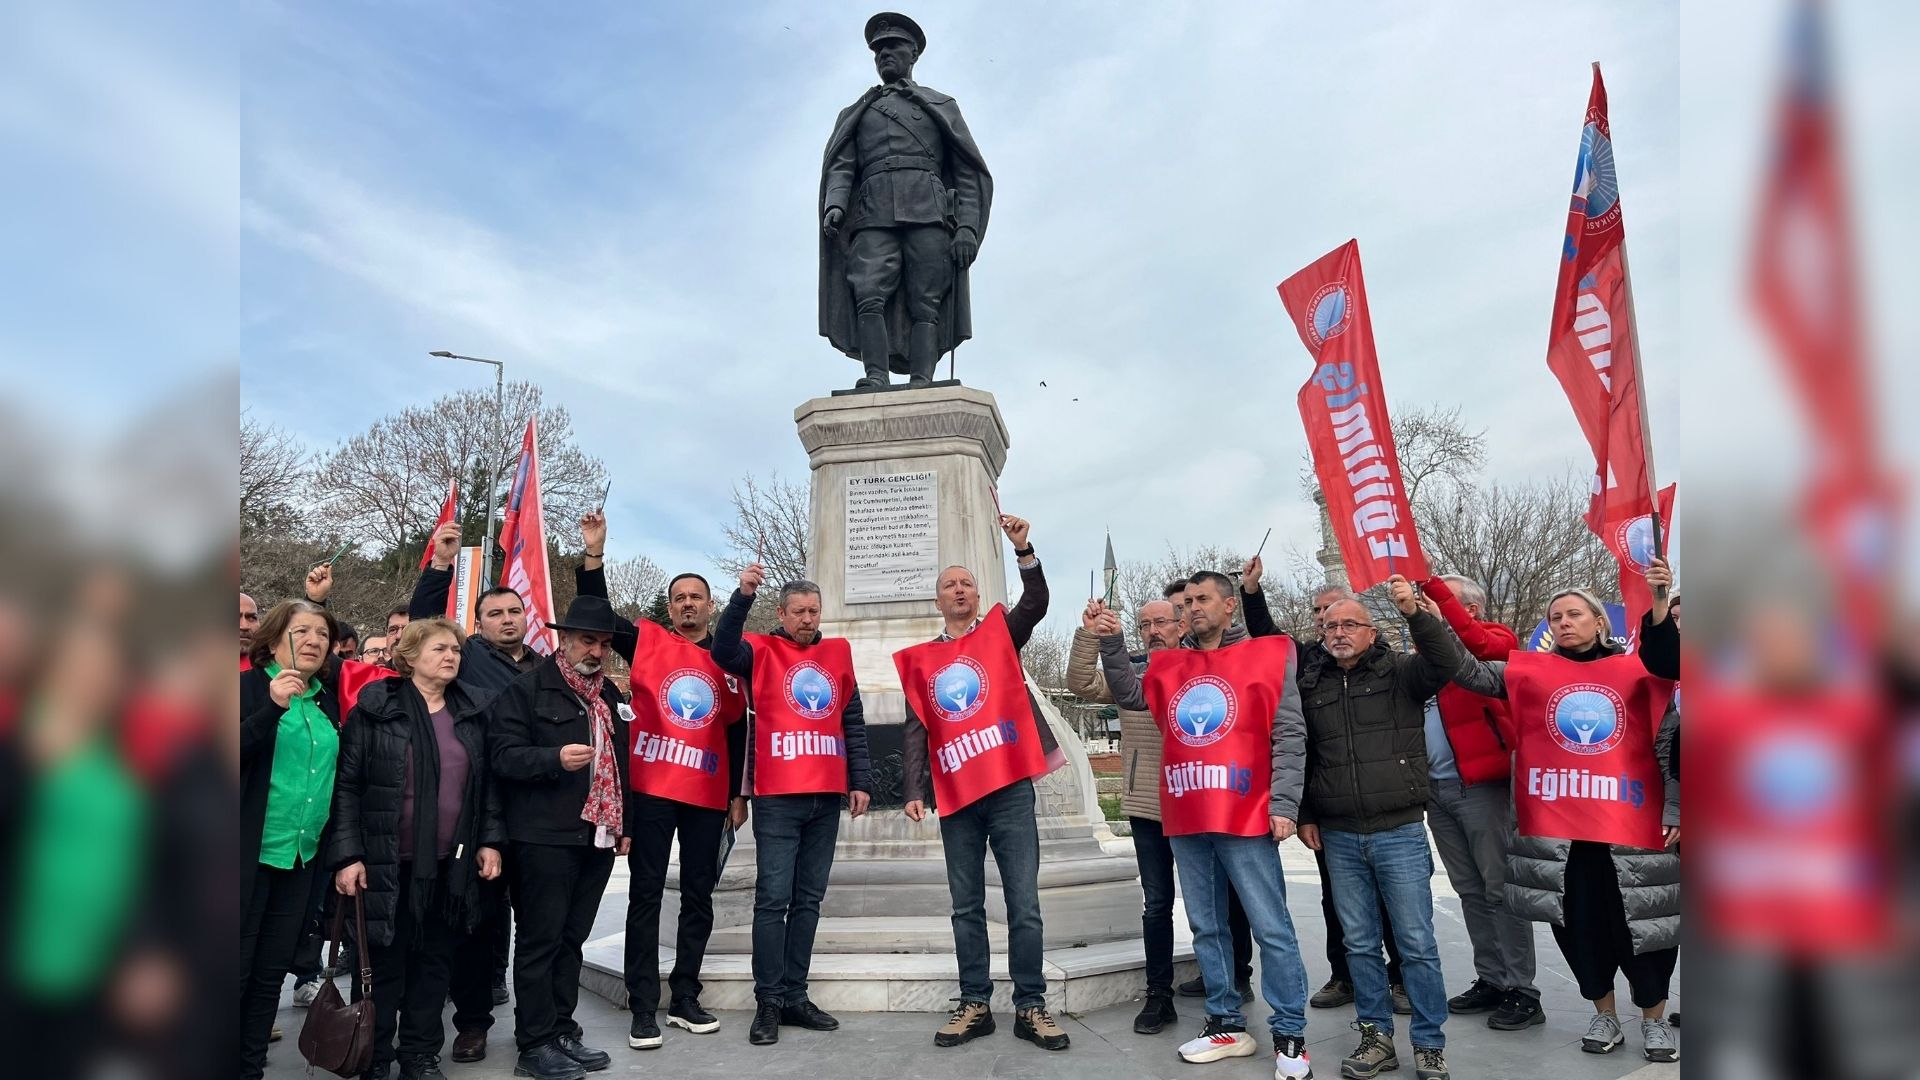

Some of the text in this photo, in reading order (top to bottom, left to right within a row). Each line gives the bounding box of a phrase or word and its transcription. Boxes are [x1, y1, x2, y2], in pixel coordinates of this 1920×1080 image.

[633, 730, 718, 778] Eğitimiş
[936, 717, 1018, 774] Eğitimiş
[1164, 760, 1252, 800] Eğitimiş
[1528, 768, 1645, 810] Eğitimiş
